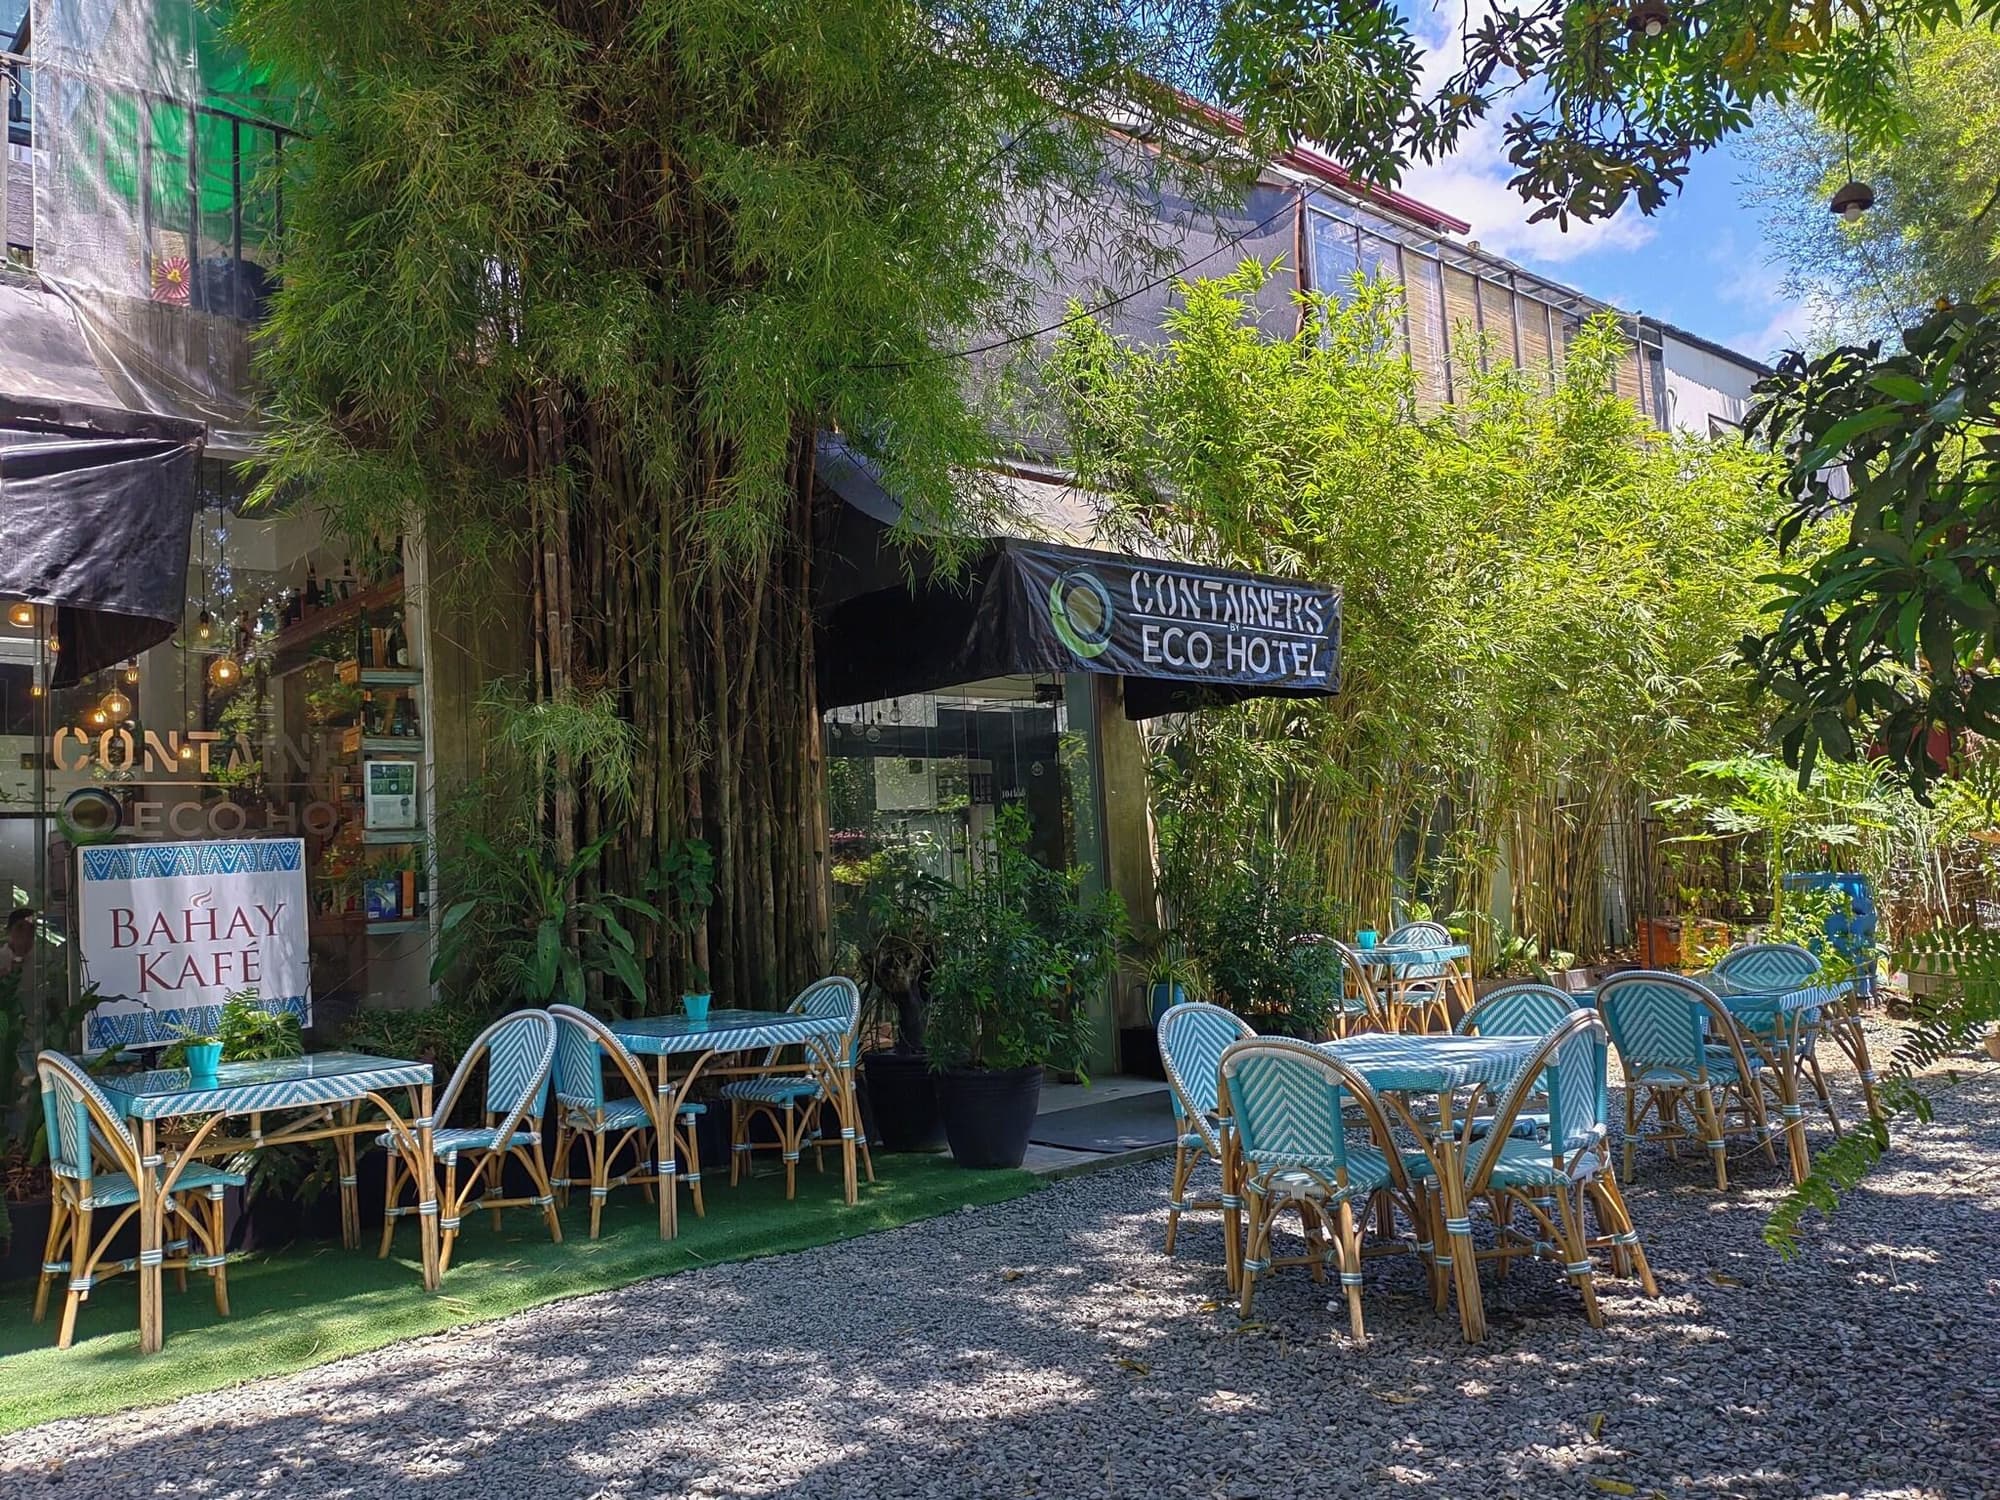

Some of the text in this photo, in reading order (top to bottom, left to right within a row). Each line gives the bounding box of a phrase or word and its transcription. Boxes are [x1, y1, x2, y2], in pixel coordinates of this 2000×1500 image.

[1131, 571, 1324, 634] CONTAINERS
[1142, 624, 1326, 677] ECO HOTEL
[1230, 623, 1240, 632] BY
[134, 802, 247, 837] ECO
[109, 903, 287, 948] BAHAY
[136, 941, 262, 993] KAFÉ
